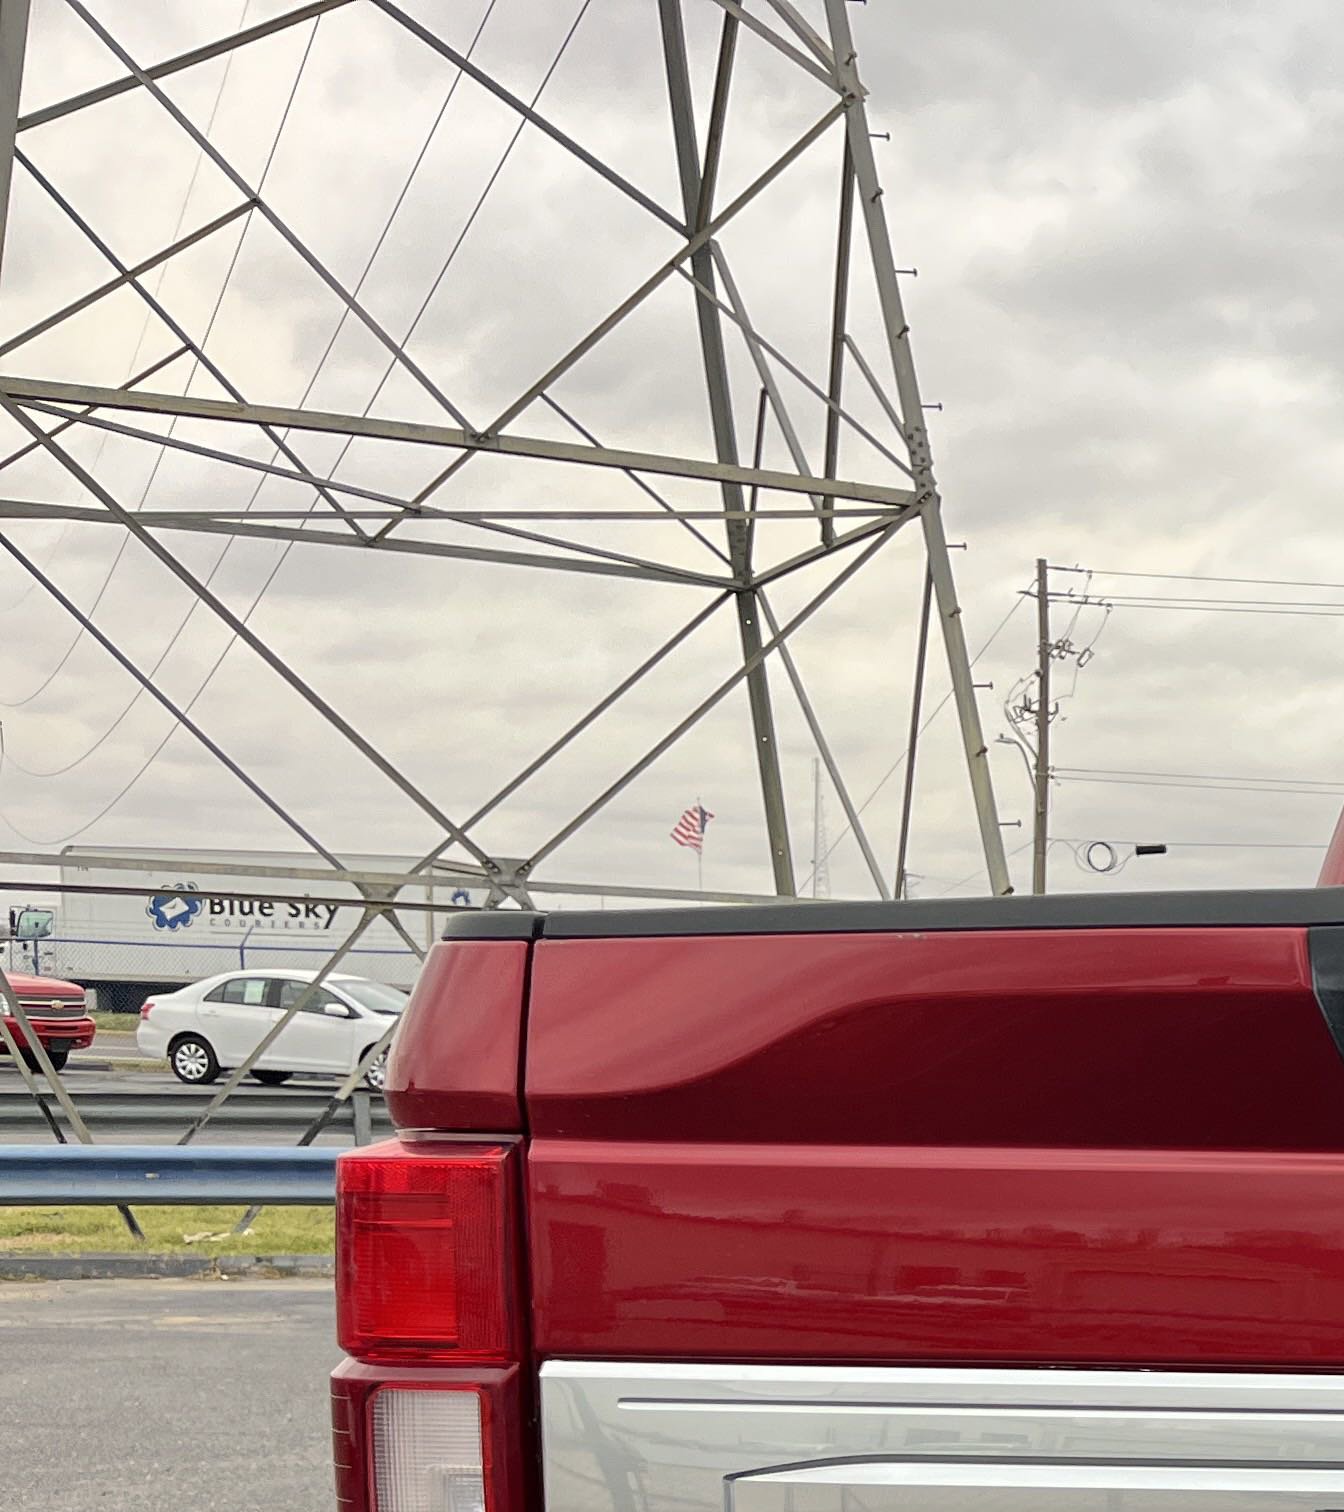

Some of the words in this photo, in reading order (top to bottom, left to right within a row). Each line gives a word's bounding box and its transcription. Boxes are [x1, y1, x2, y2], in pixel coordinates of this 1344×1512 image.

[209, 898, 275, 917] Blue
[287, 901, 340, 930] Sky
[209, 918, 321, 930] COURIERS
